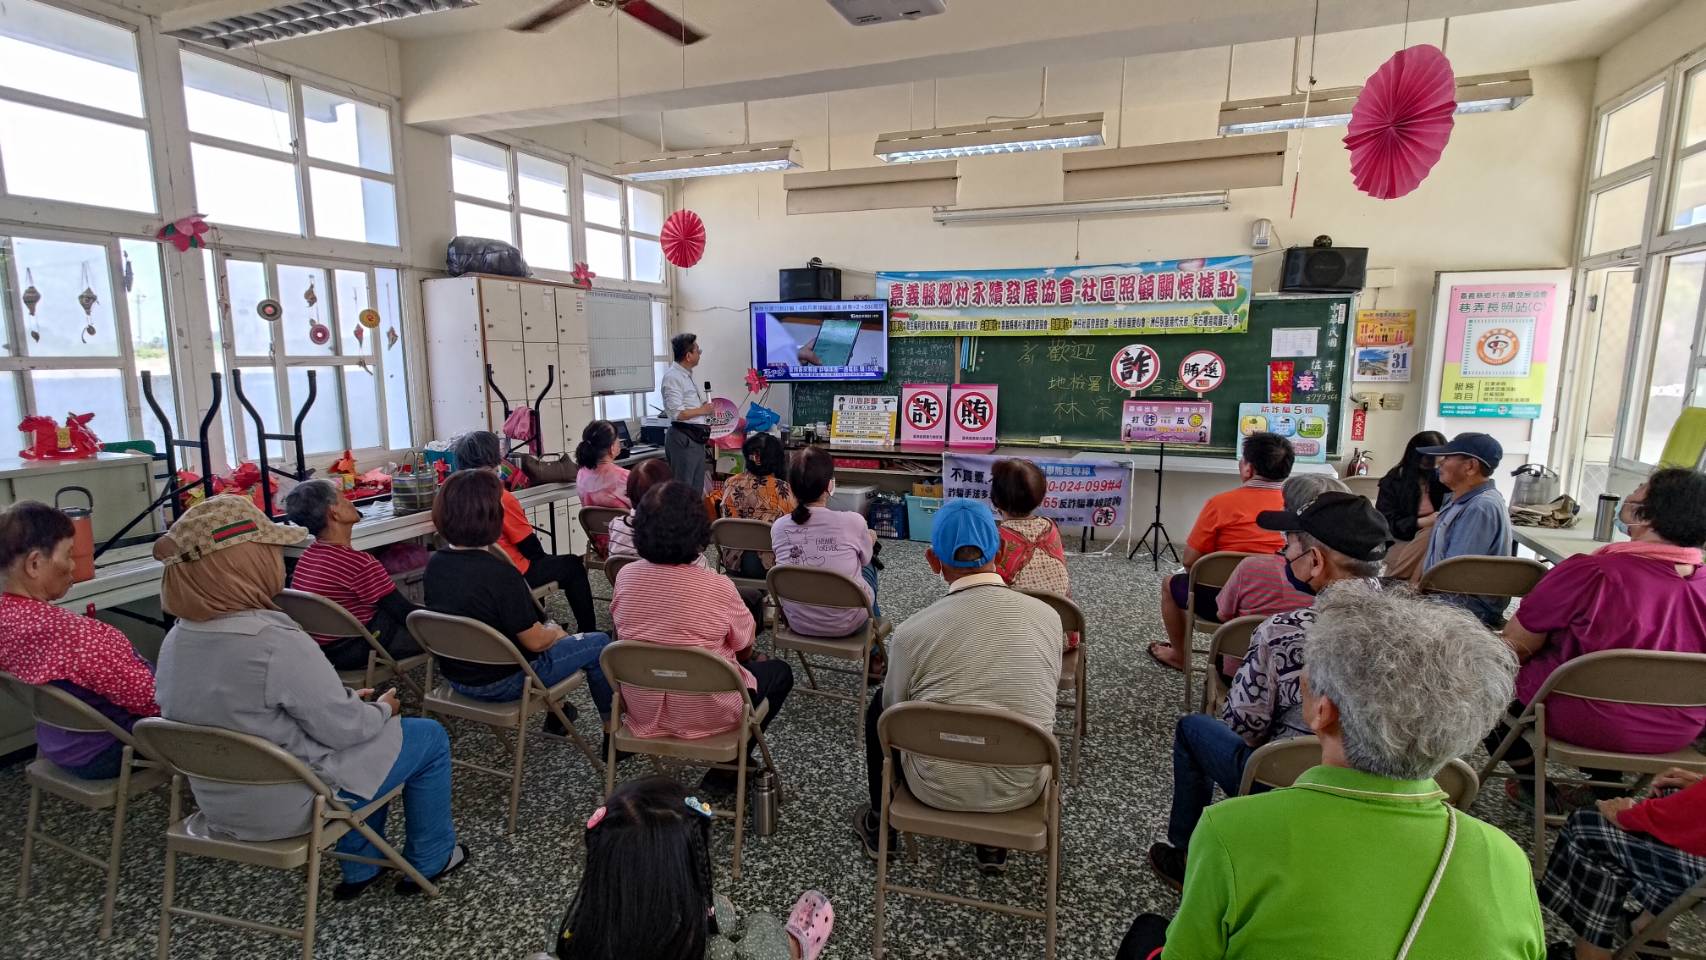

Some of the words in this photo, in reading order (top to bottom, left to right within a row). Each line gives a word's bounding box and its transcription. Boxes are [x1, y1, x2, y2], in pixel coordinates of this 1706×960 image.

[890, 271, 1236, 307] 嘉義縣鄉村永續發展協會-社區照顧關懷據點
[1119, 350, 1151, 382] 詐
[1183, 361, 1220, 379] 賄選
[1391, 352, 1408, 370] 31
[912, 398, 937, 424] 詐
[961, 399, 987, 426] 賄
[947, 487, 993, 500] 詐騙手法多
